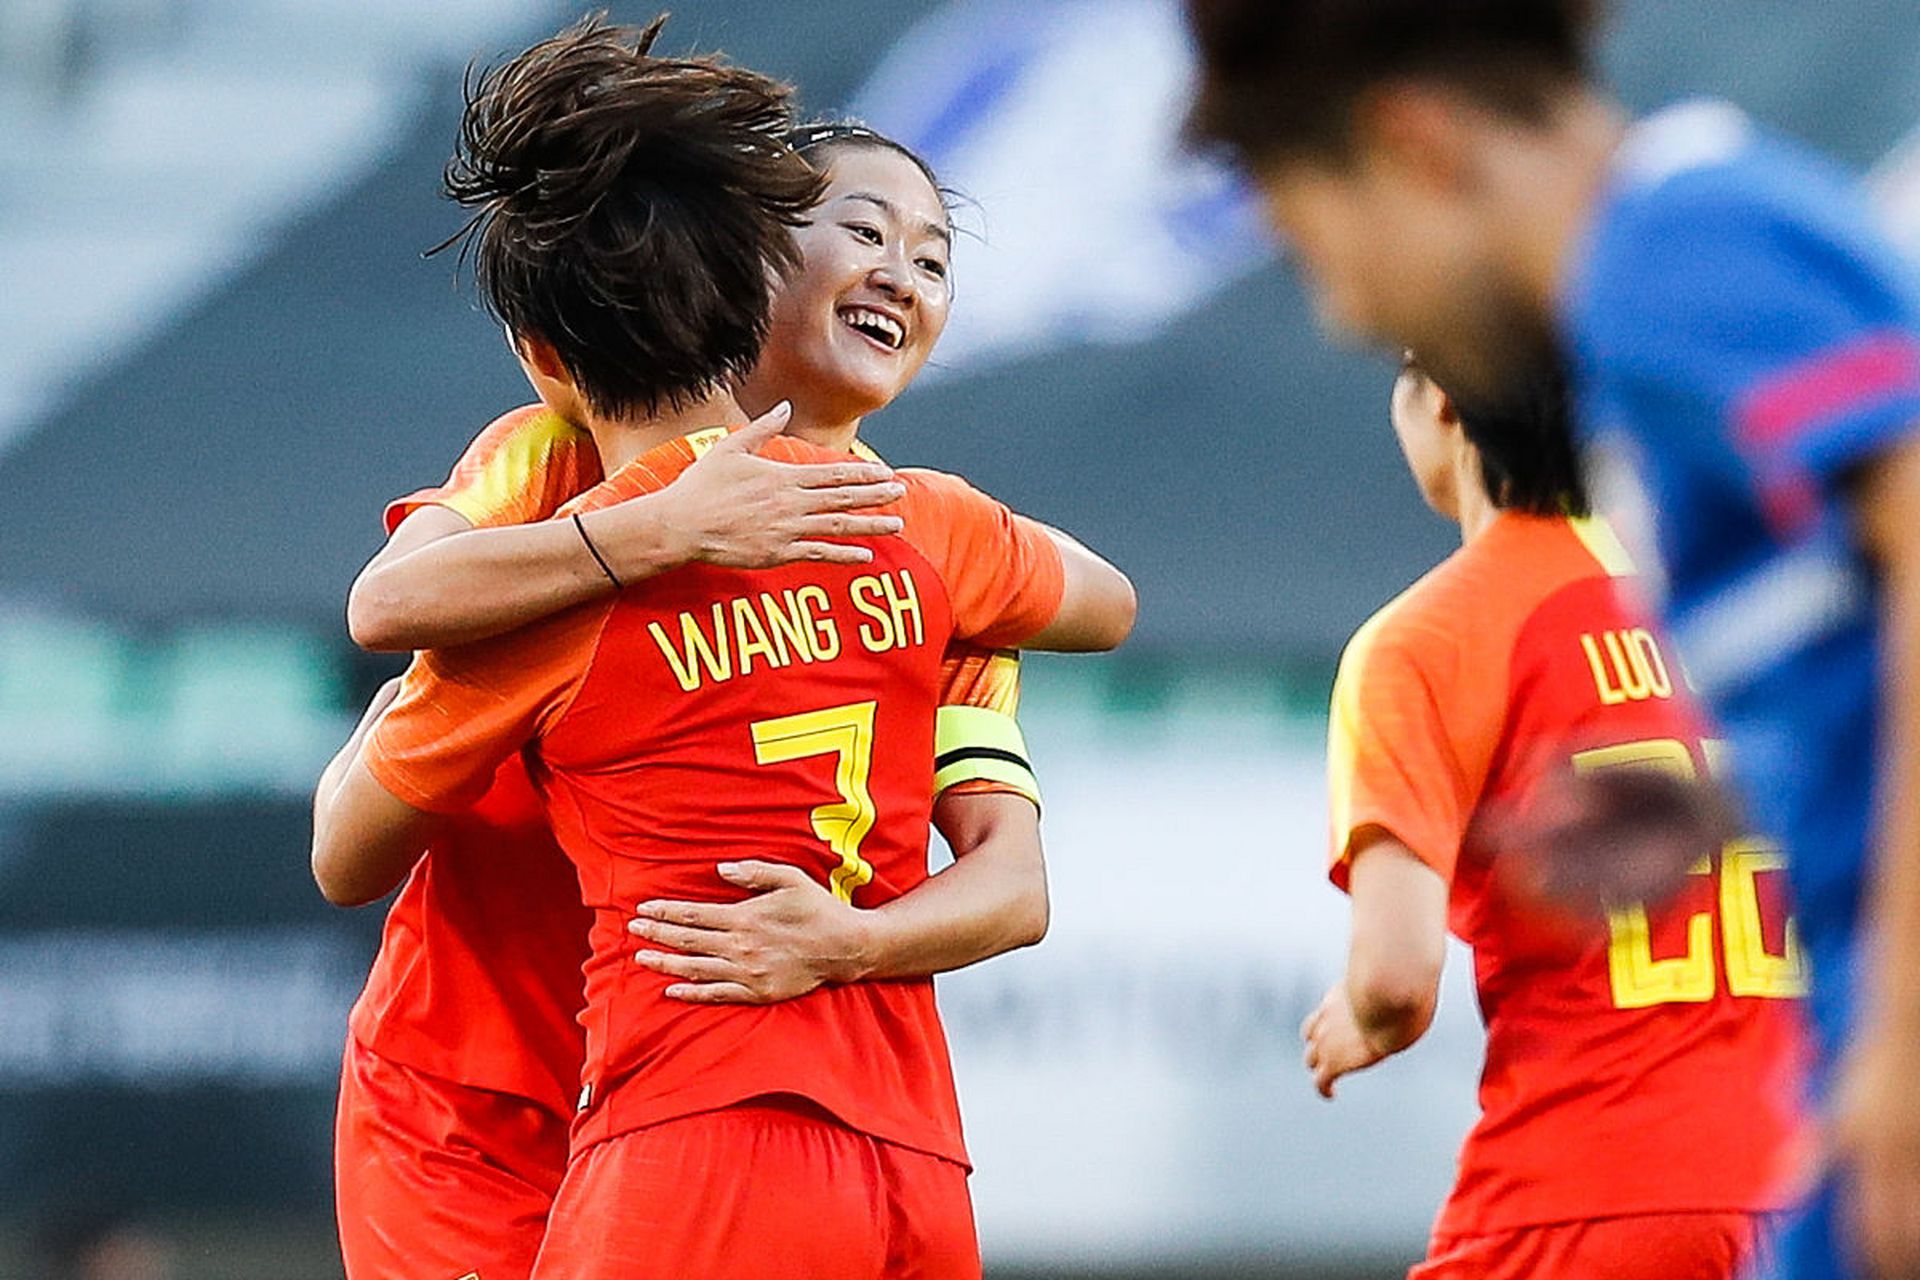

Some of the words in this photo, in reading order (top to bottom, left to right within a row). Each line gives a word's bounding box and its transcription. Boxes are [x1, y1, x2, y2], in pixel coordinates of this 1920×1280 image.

[648, 585, 841, 692] WANG
[849, 569, 924, 653] SH
[1580, 627, 1672, 705] LUO
[750, 700, 878, 906] 7
